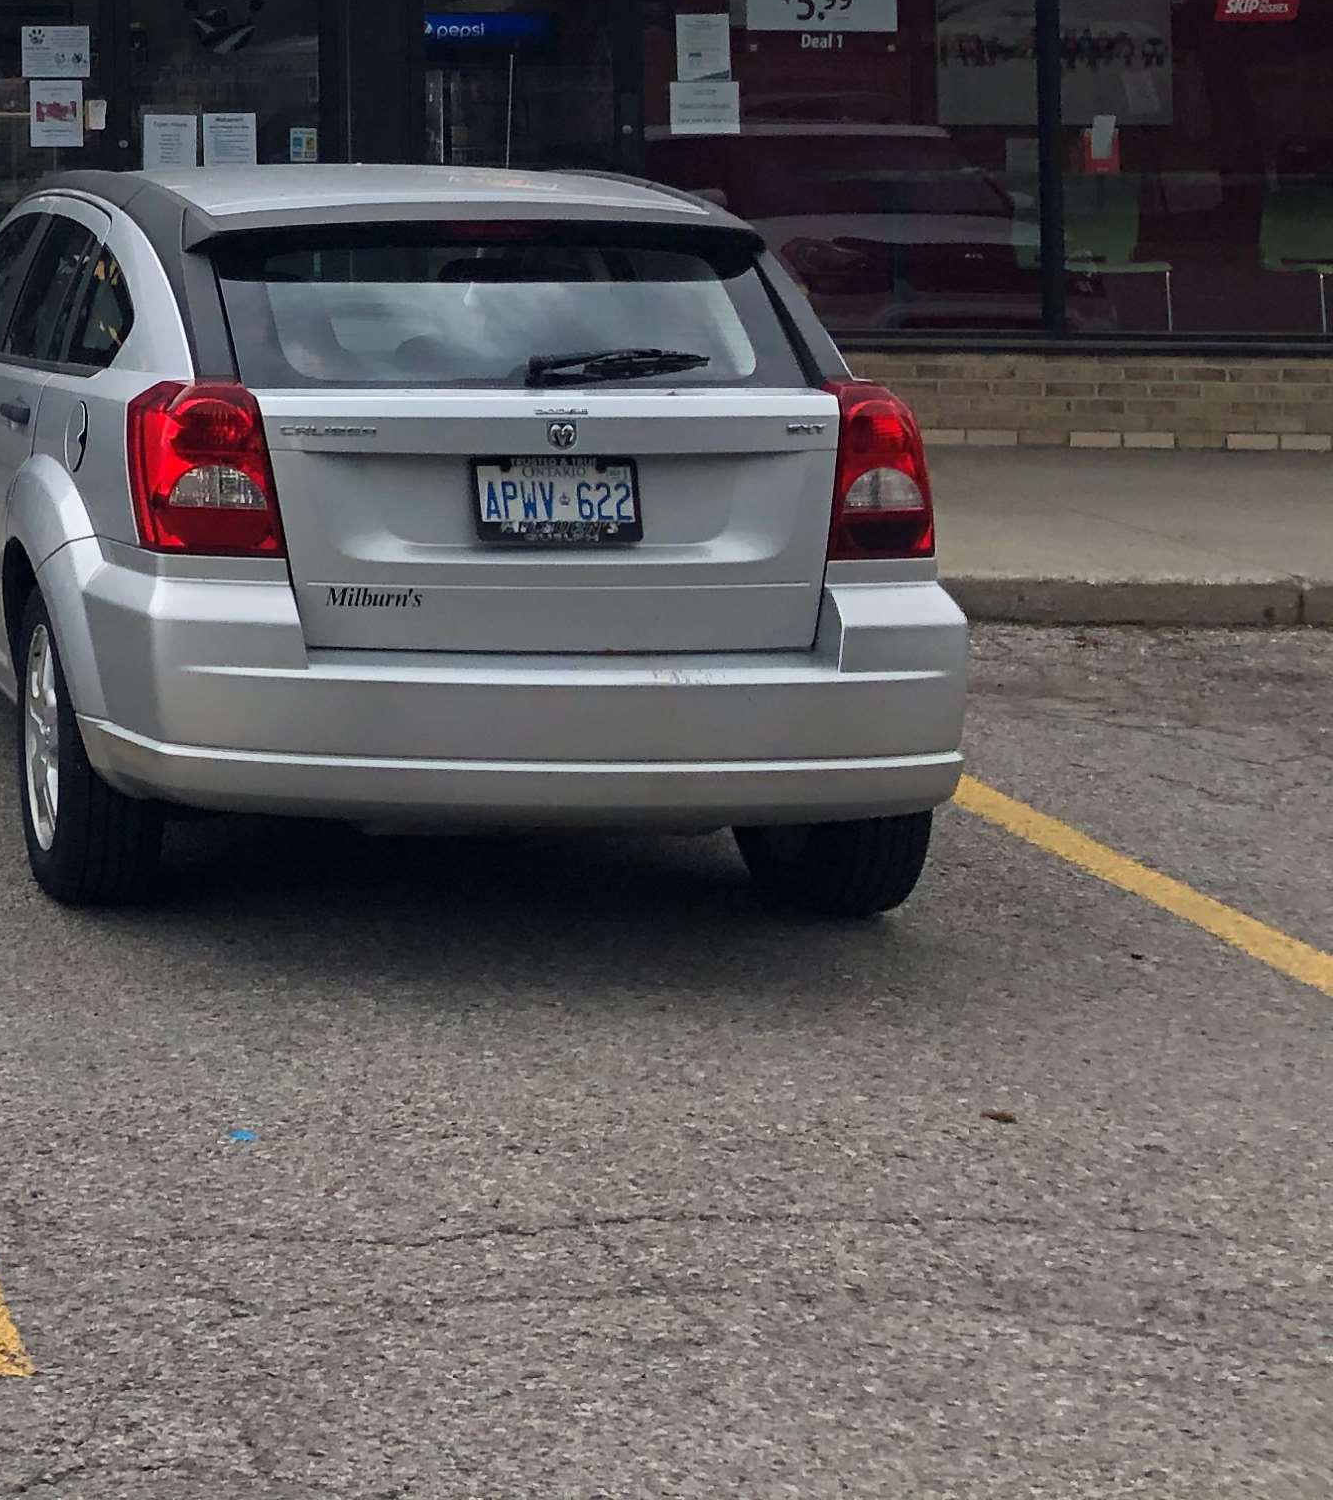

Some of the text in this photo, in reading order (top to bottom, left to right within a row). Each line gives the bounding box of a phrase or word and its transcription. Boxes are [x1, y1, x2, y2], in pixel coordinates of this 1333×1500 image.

[436, 22, 485, 40] pepsi
[801, 33, 844, 48] Deal 1
[522, 466, 587, 478] ONTARIO
[486, 481, 633, 520] APWV 622
[325, 587, 423, 608] Milburn's
